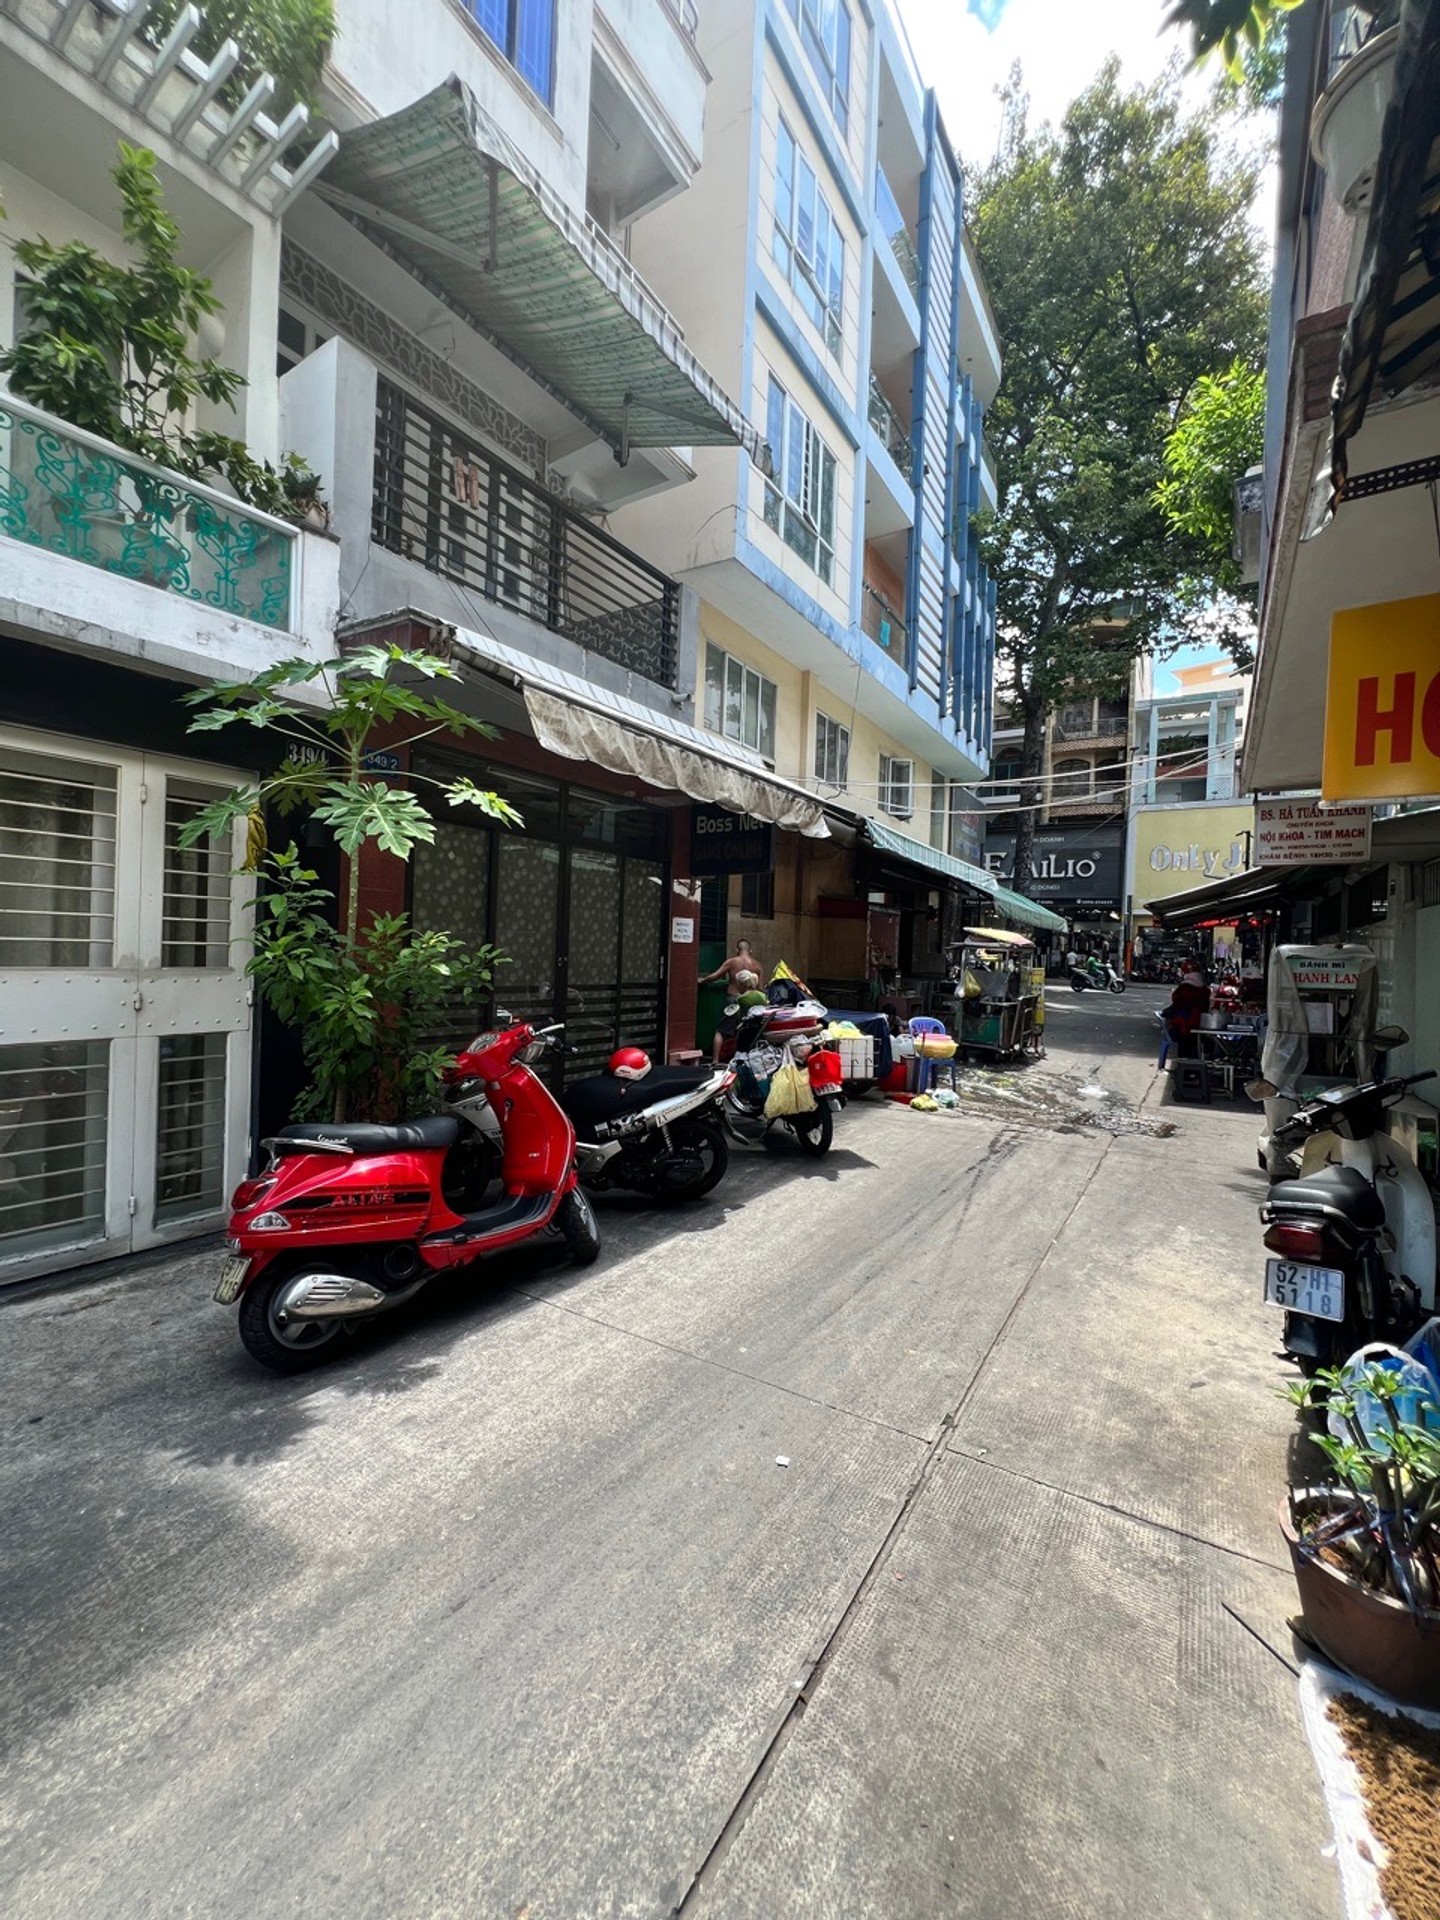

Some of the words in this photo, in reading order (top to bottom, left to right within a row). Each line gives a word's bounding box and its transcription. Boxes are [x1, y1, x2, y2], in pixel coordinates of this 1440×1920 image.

[367, 753, 398, 770] 349/2
[696, 815, 733, 834] Boss
[1278, 832, 1304, 841] KHOA
[1314, 829, 1332, 840] TIM
[1335, 828, 1365, 840] MẠCH
[1293, 972, 1329, 984] HANH
[1276, 1263, 1329, 1292] 52-H1
[1275, 1285, 1332, 1315] 5118
